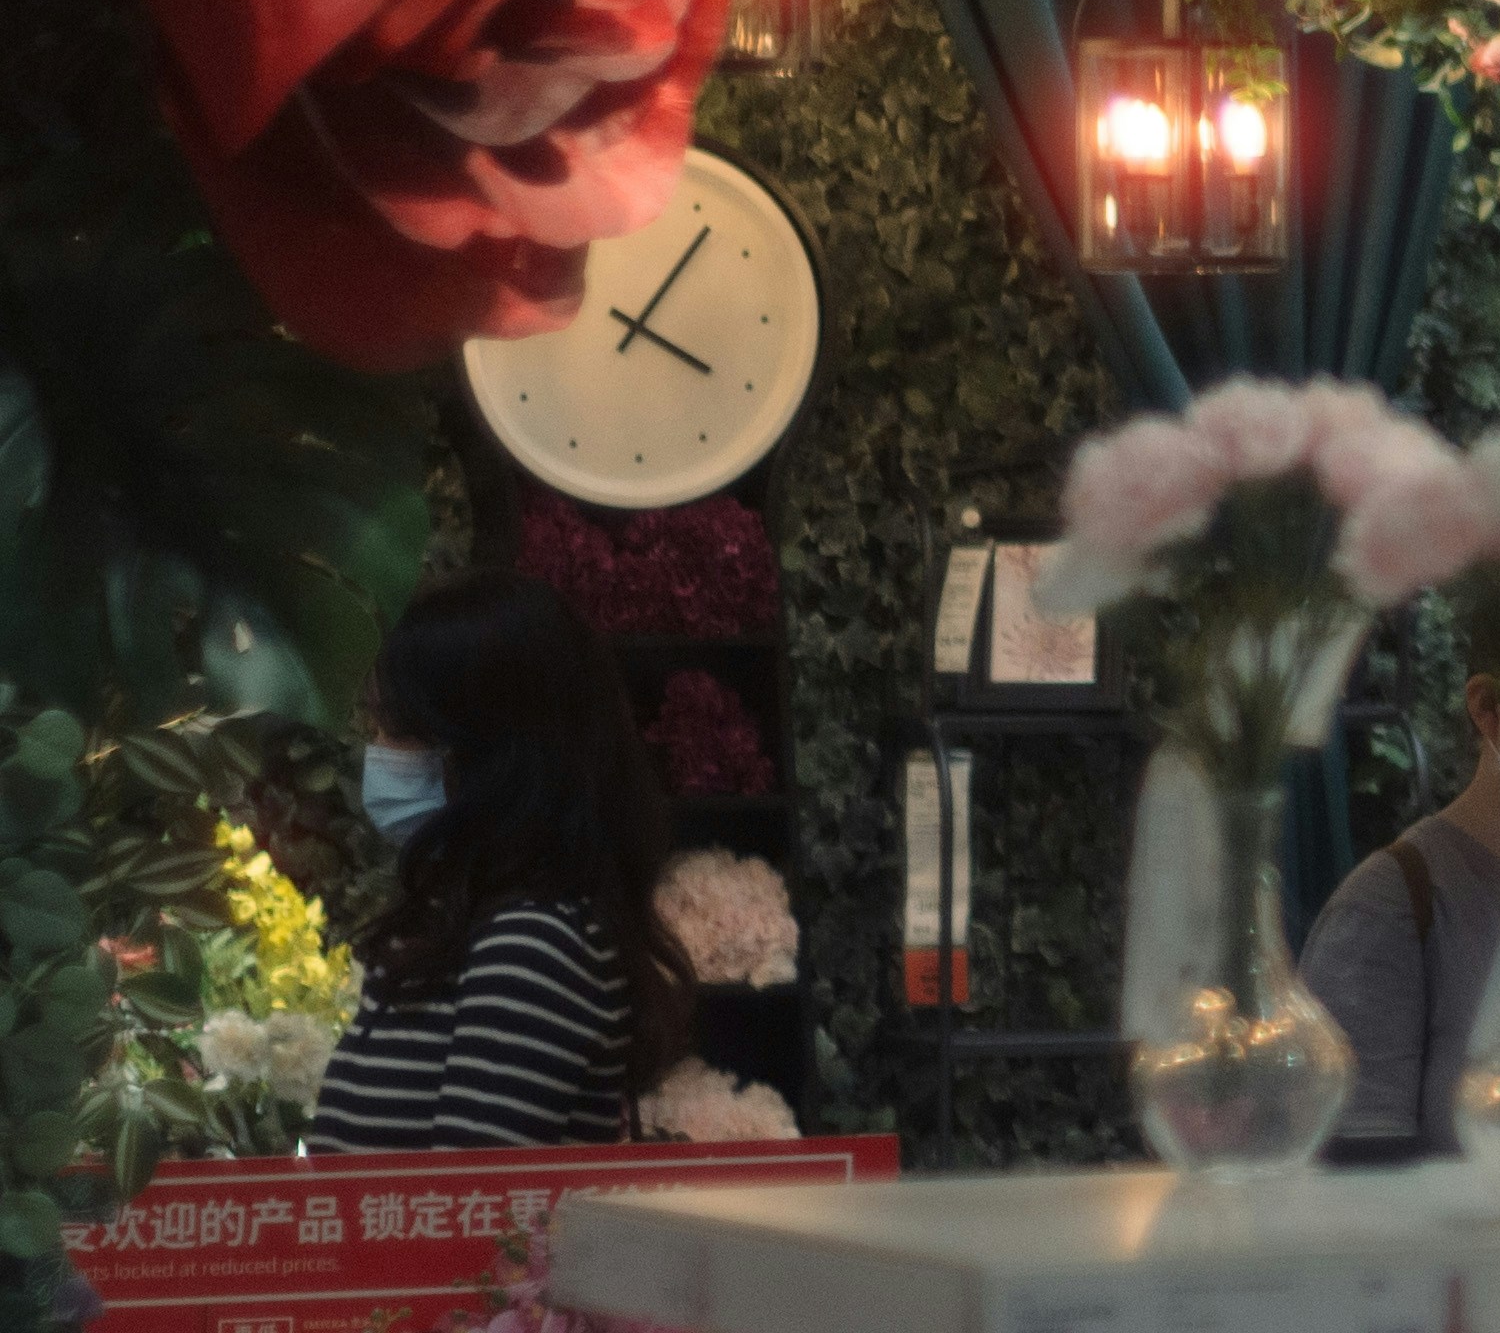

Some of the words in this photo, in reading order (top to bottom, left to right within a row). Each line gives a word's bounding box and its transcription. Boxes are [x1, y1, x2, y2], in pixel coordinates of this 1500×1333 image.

[113, 1261, 175, 1279] locked
[178, 1263, 198, 1277] at
[201, 1257, 278, 1276] reduced
